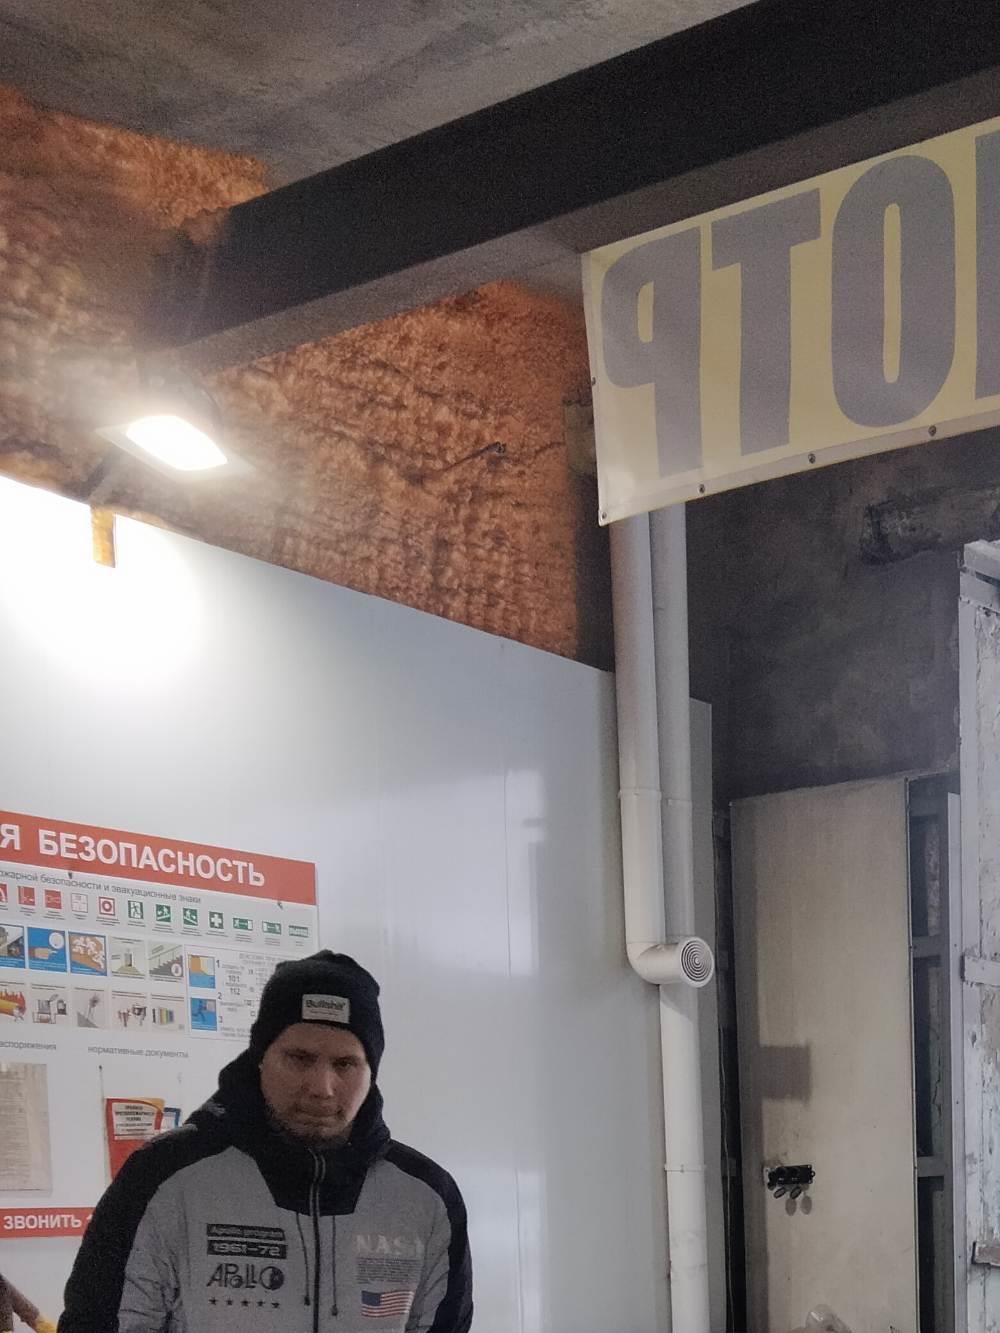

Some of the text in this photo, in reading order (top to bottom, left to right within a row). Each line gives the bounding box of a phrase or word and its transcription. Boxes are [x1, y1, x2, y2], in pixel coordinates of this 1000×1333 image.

[38, 828, 266, 887] БЕЗОПАСНОСТЬ
[40, 873, 102, 890] безопасности
[87, 1045, 189, 1060] нормативные документы
[3, 1214, 82, 1230] ЗВОНИТЬ
